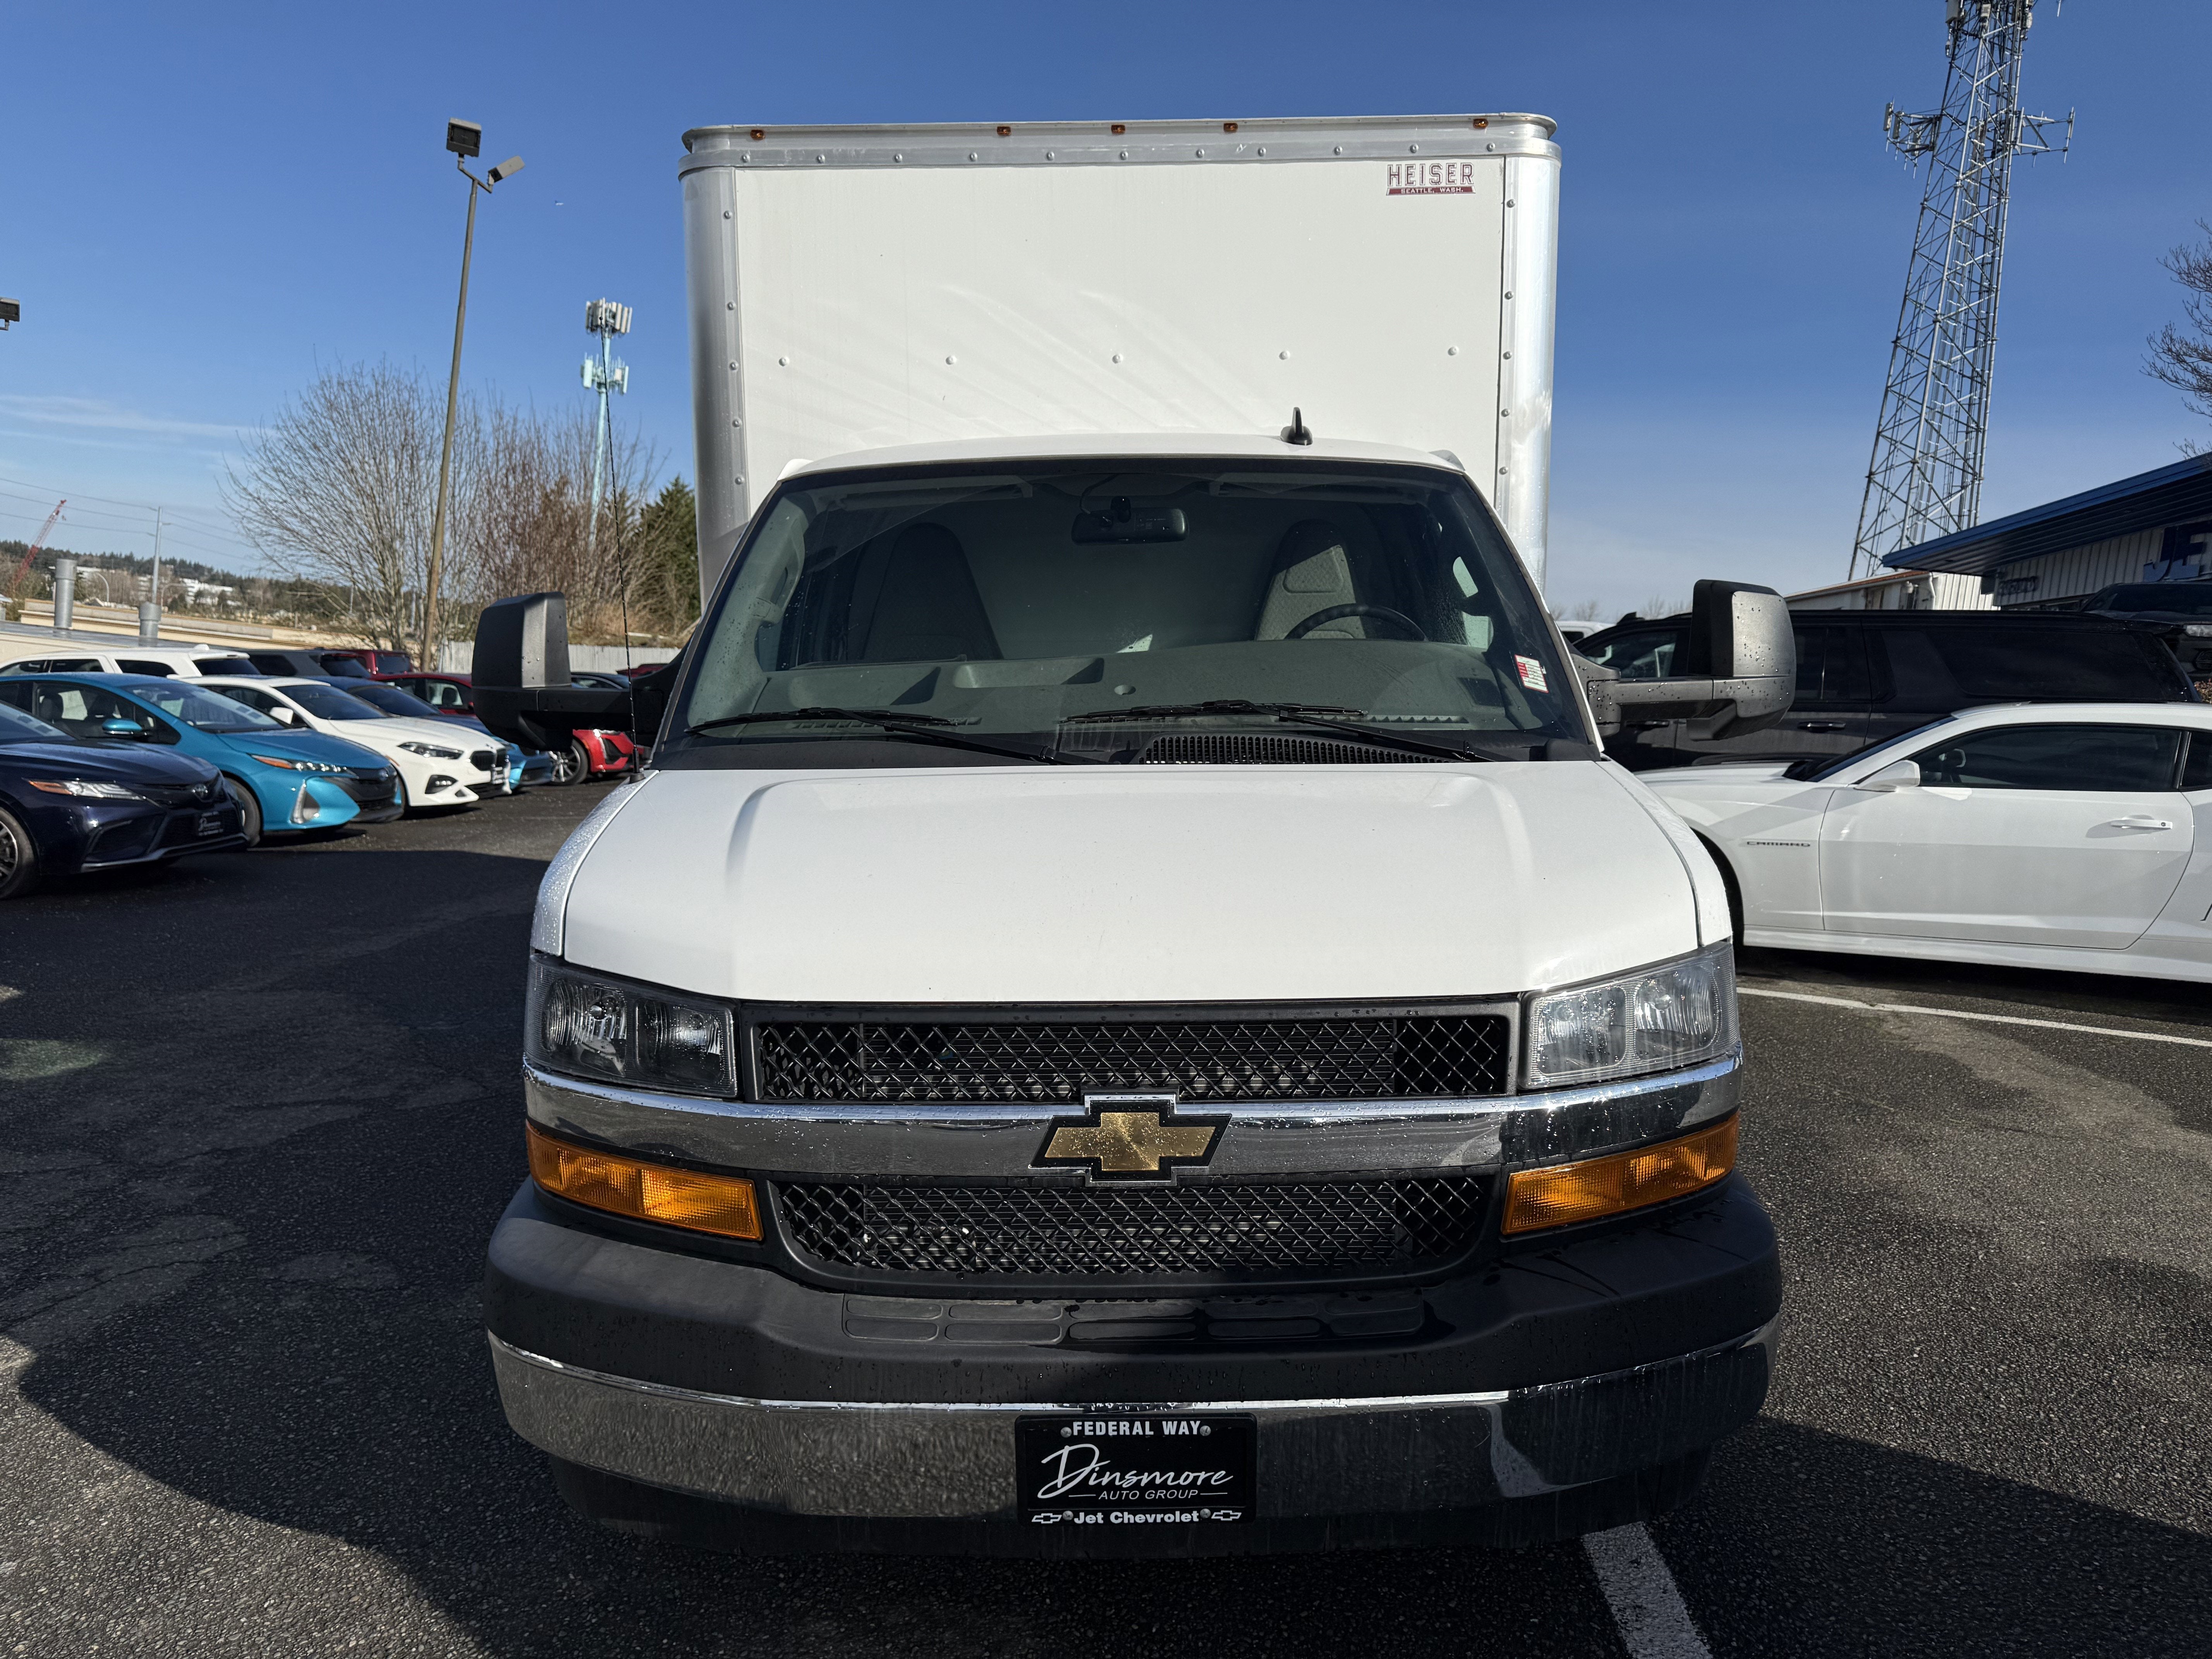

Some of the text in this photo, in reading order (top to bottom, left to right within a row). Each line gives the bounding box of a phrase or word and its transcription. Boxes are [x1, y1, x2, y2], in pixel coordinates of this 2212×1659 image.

[1387, 162, 1474, 186] HEISER
[2143, 520, 2212, 582] JE
[1072, 1420, 1201, 1436] FEDERAL WAY
[1037, 1443, 1233, 1498] Dinsmore
[1098, 1489, 1199, 1500] AUTO GROUP
[1074, 1510, 1199, 1524] Jet Chevrolet
